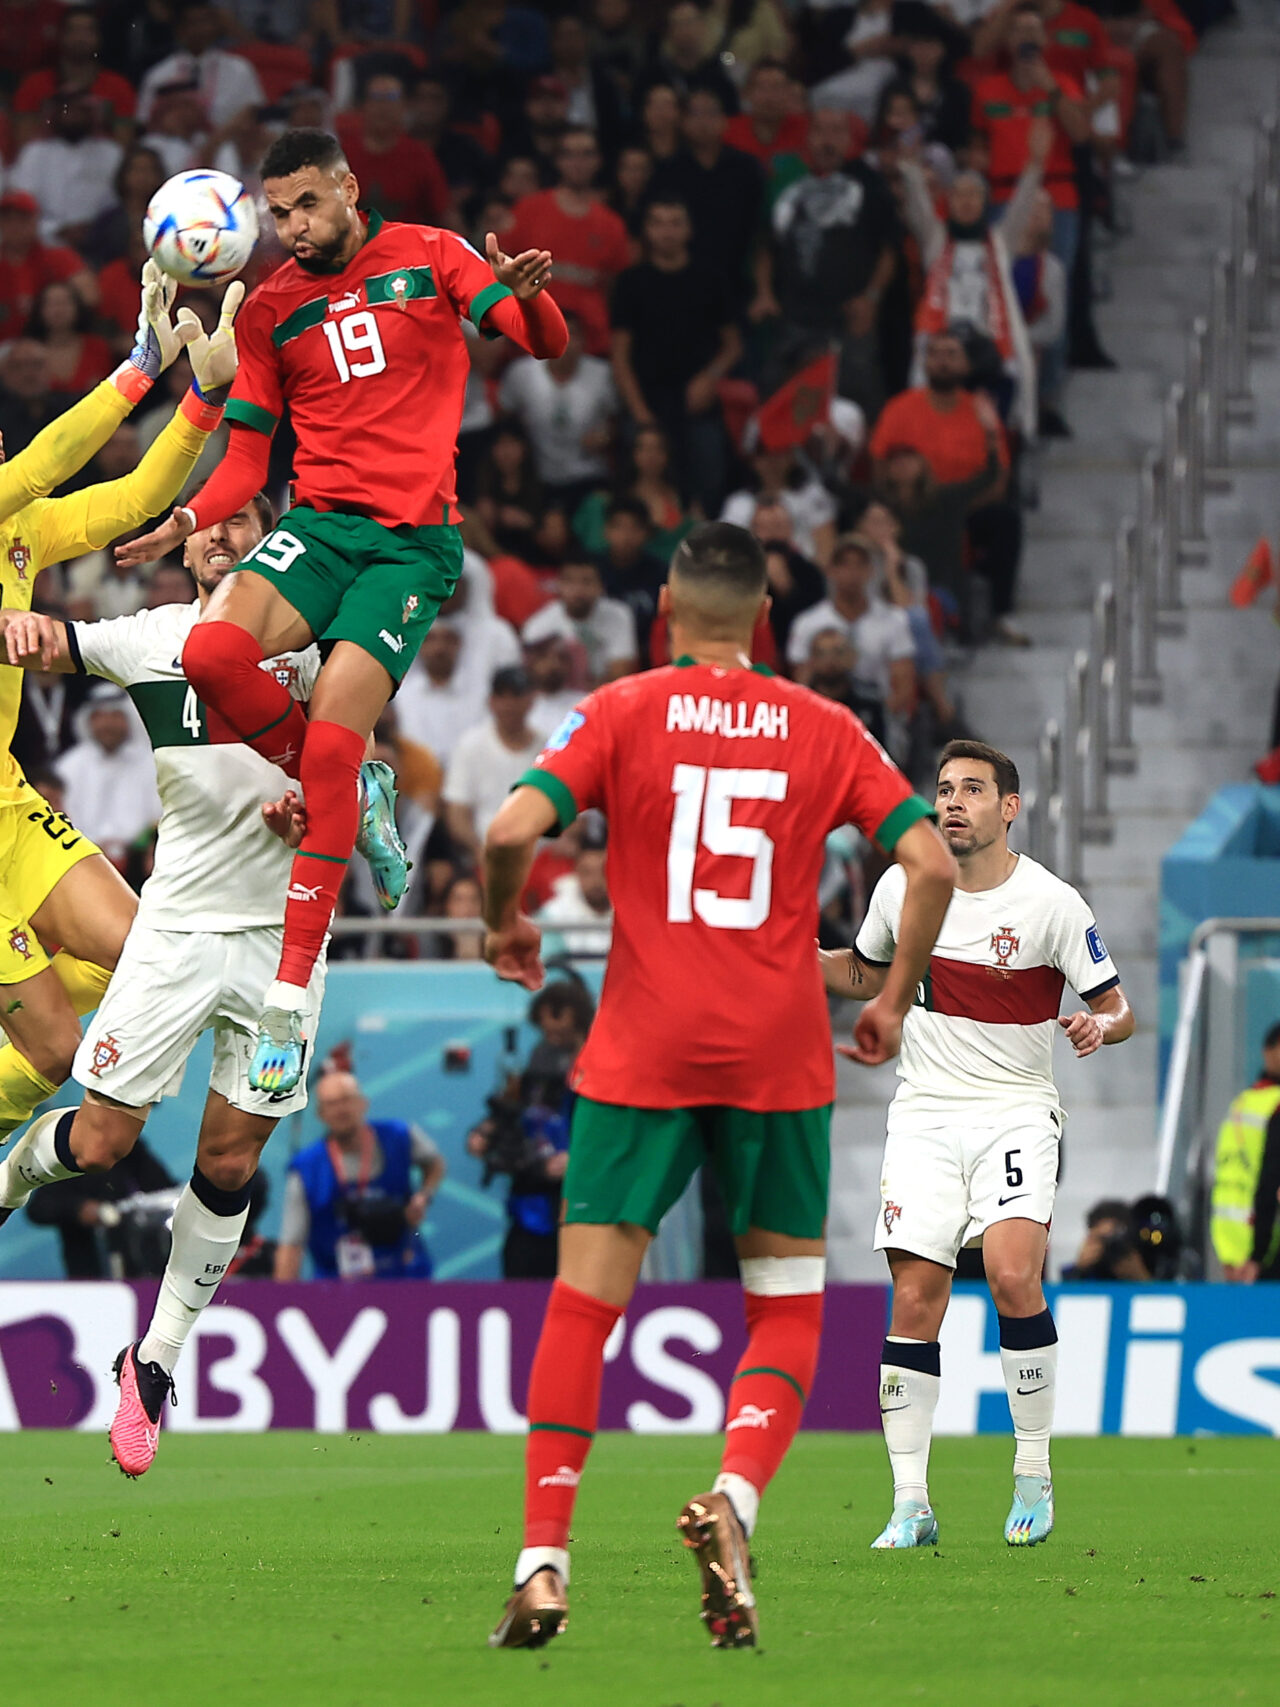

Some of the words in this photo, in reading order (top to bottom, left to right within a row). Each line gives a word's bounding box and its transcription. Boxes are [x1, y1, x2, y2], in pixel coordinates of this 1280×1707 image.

[322, 310, 387, 384] 19
[240, 529, 308, 573] 19
[182, 684, 202, 738] 4
[666, 694, 789, 741] AMALLAH
[666, 763, 790, 931] 15
[1004, 1148, 1024, 1188] 5
